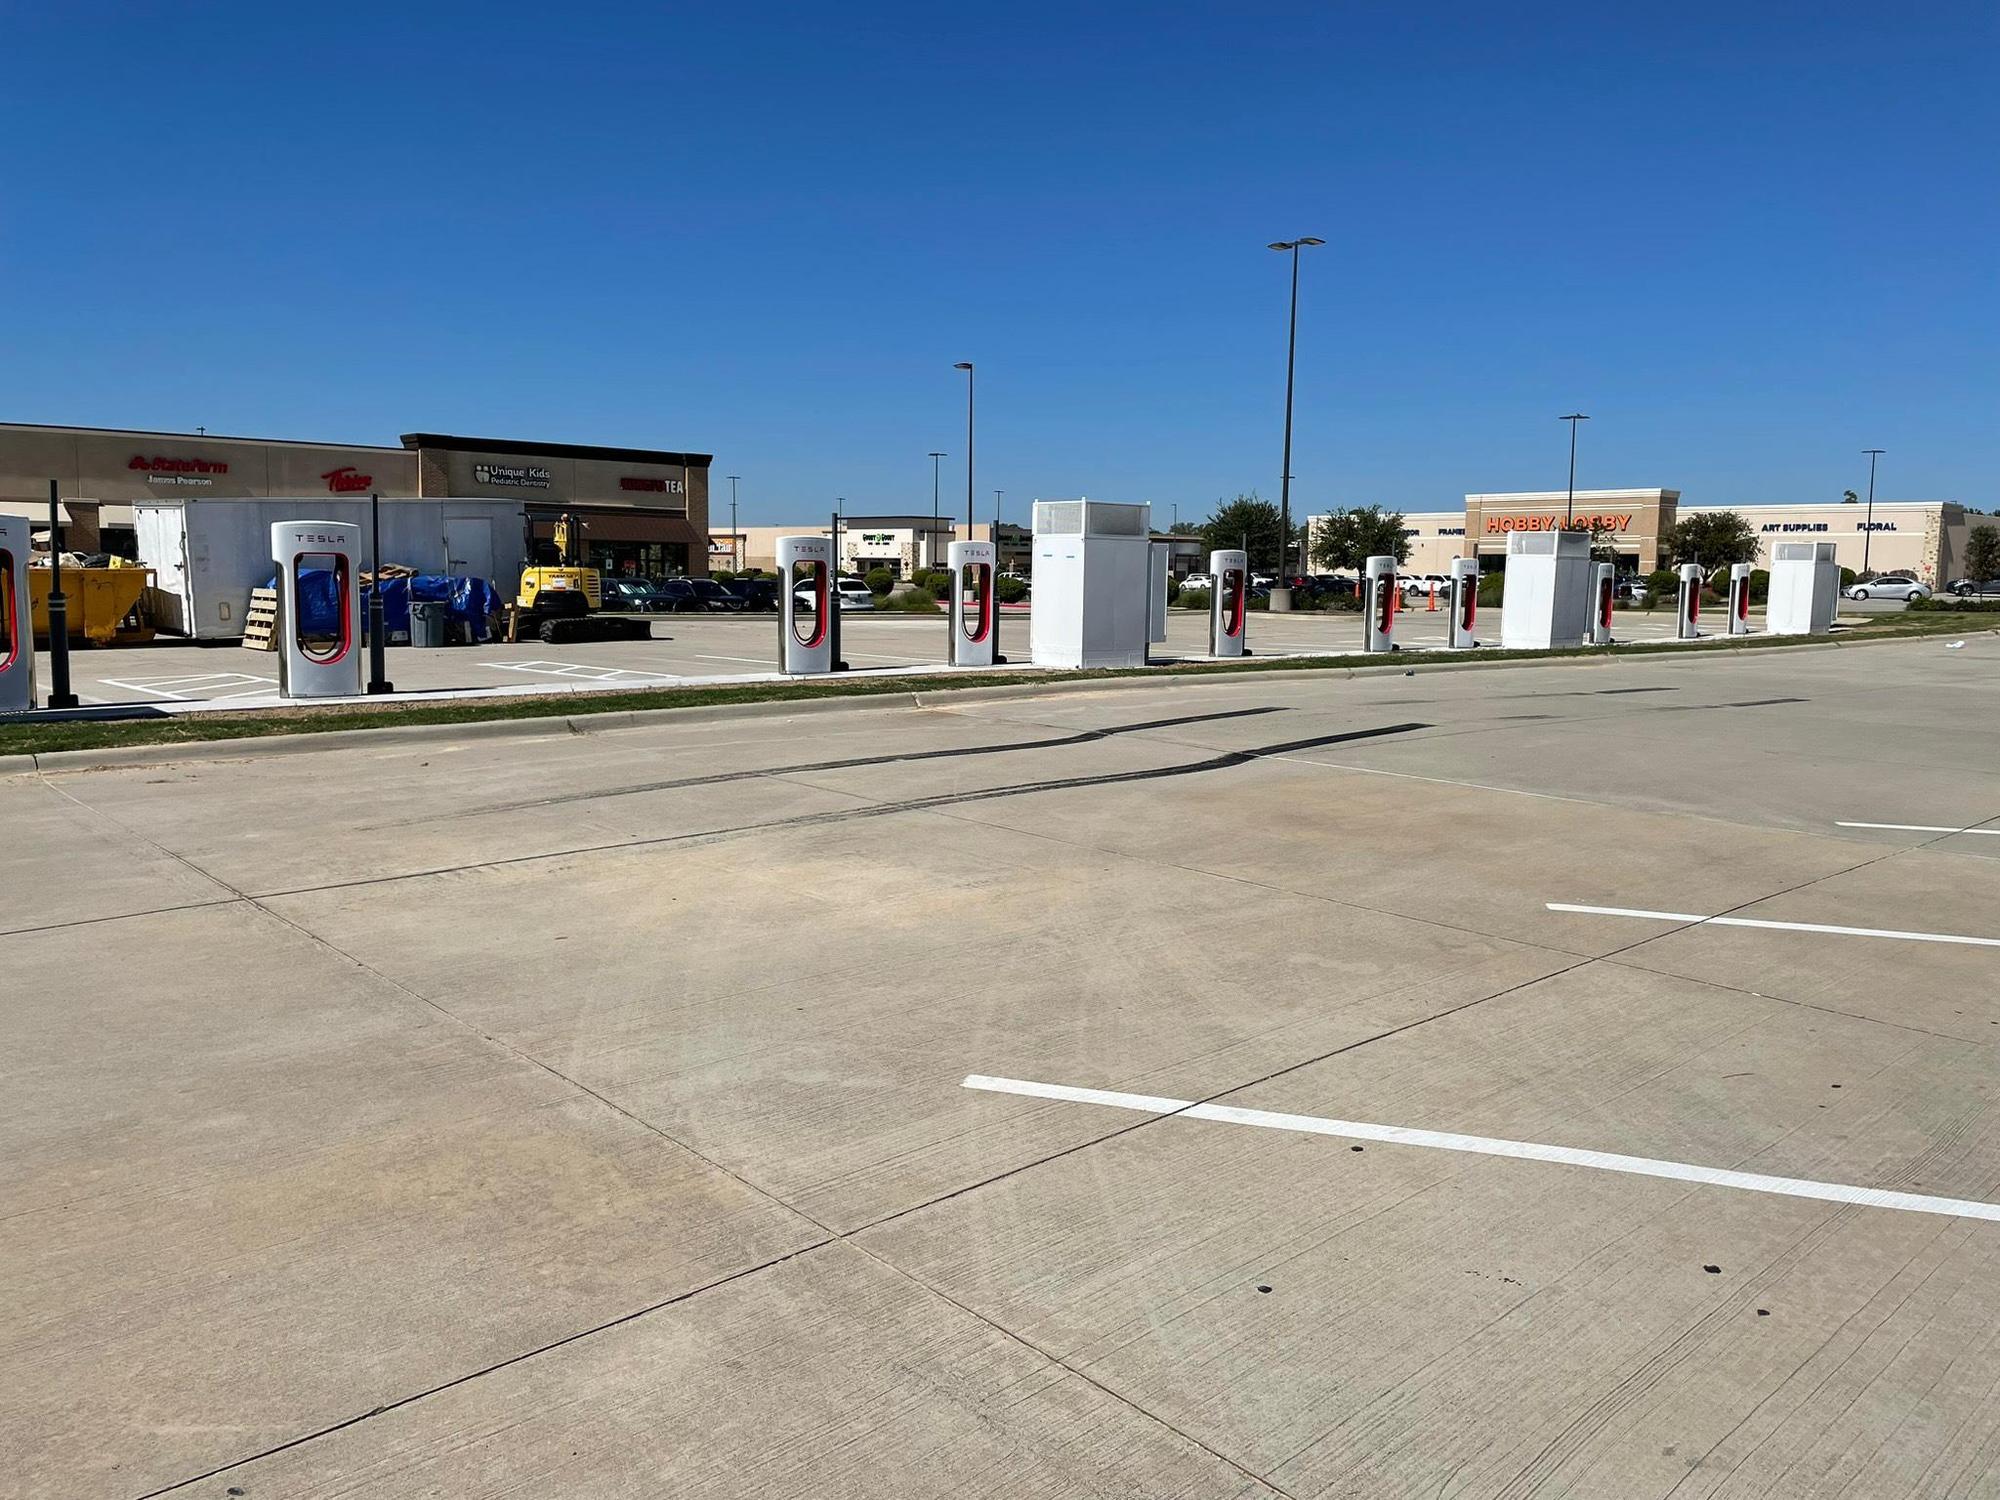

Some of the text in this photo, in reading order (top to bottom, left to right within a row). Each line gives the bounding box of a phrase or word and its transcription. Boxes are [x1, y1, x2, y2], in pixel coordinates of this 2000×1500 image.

[490, 465, 551, 479] Unique Kids
[491, 477, 551, 489] Pediatric Dentistry
[664, 480, 684, 495] TEA
[1487, 515, 1555, 533] HOBBY
[1761, 523, 1829, 532] ART SUPPLIES
[1856, 522, 1897, 531] FLORAL
[295, 534, 345, 543] TESLA
[793, 545, 825, 553] TESLA
